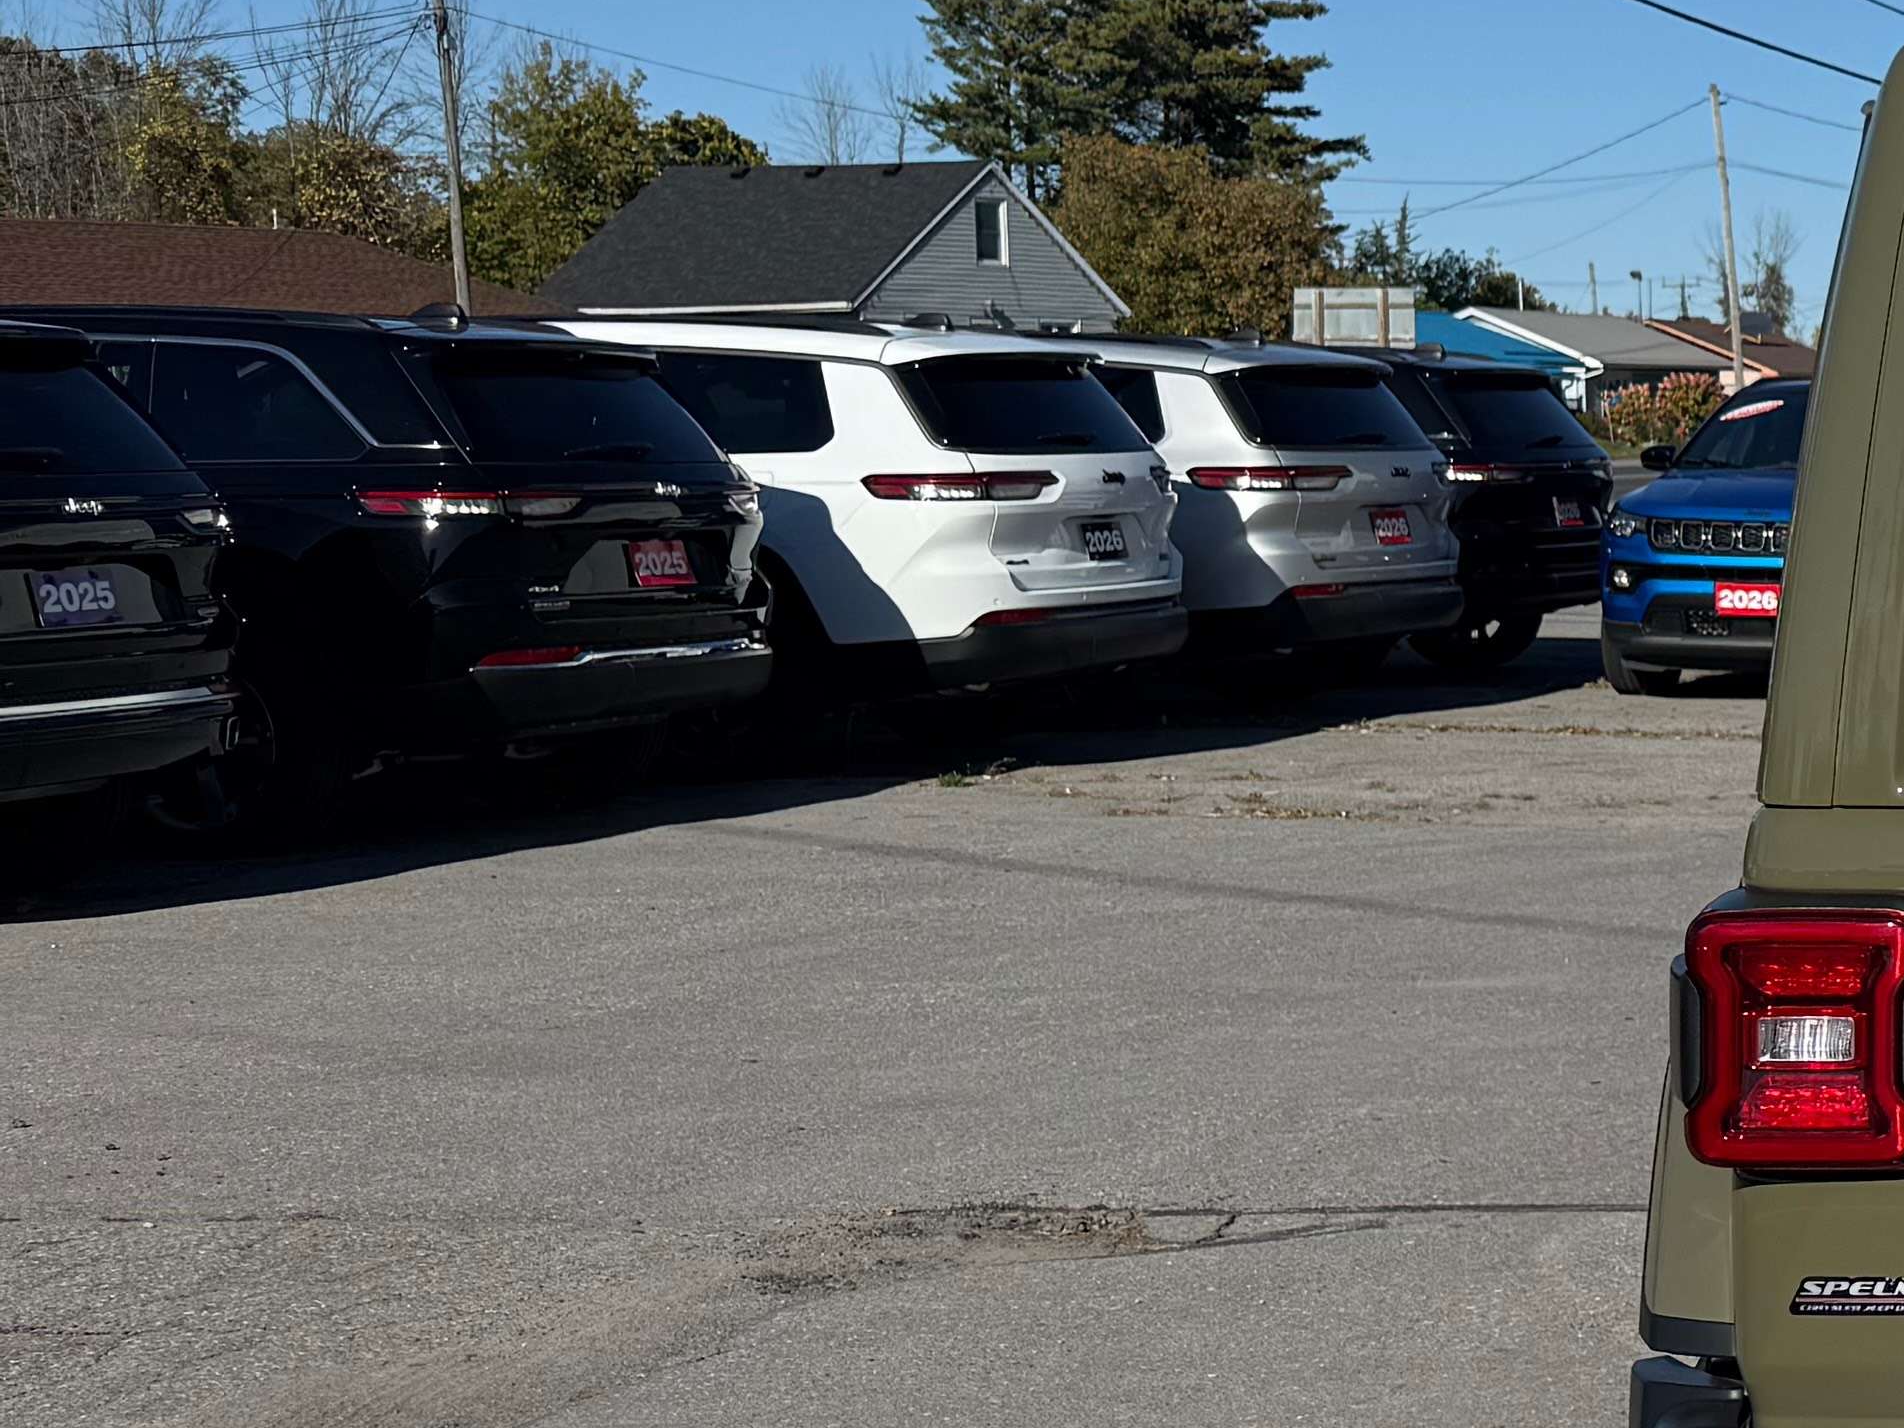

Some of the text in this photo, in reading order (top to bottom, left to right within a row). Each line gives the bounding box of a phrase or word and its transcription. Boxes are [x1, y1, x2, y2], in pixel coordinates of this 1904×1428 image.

[1376, 518, 1409, 537] 2026
[1085, 529, 1124, 553] 2026
[634, 552, 687, 576] 2025
[39, 581, 115, 612] 2025
[1719, 589, 1779, 611] 2026
